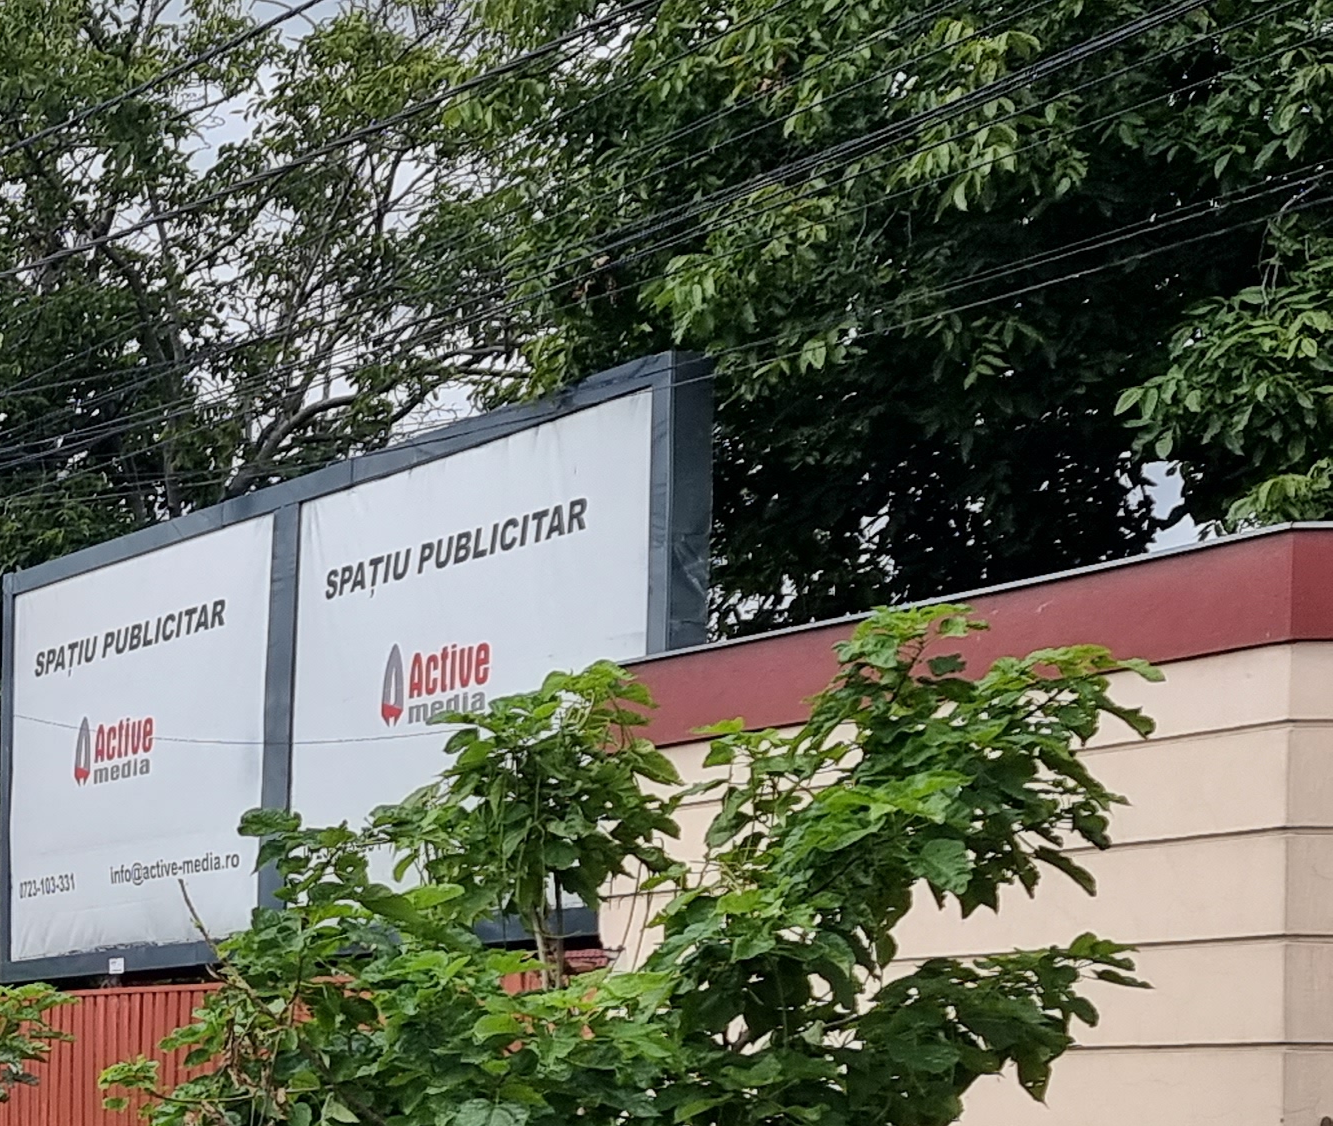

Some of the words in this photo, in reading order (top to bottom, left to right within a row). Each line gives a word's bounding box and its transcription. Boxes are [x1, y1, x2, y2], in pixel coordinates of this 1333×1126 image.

[325, 548, 412, 600] SPAȚIU
[417, 498, 588, 575] PUBLICITAR
[34, 636, 98, 678] SPAȚIU
[102, 599, 226, 659] PUBLICITAR
[408, 642, 490, 699] Active
[407, 691, 486, 724] media
[94, 717, 154, 763] Active
[93, 757, 151, 784] media
[19, 873, 75, 899] 0723-103-331
[110, 852, 240, 886] info@active-media.ro
